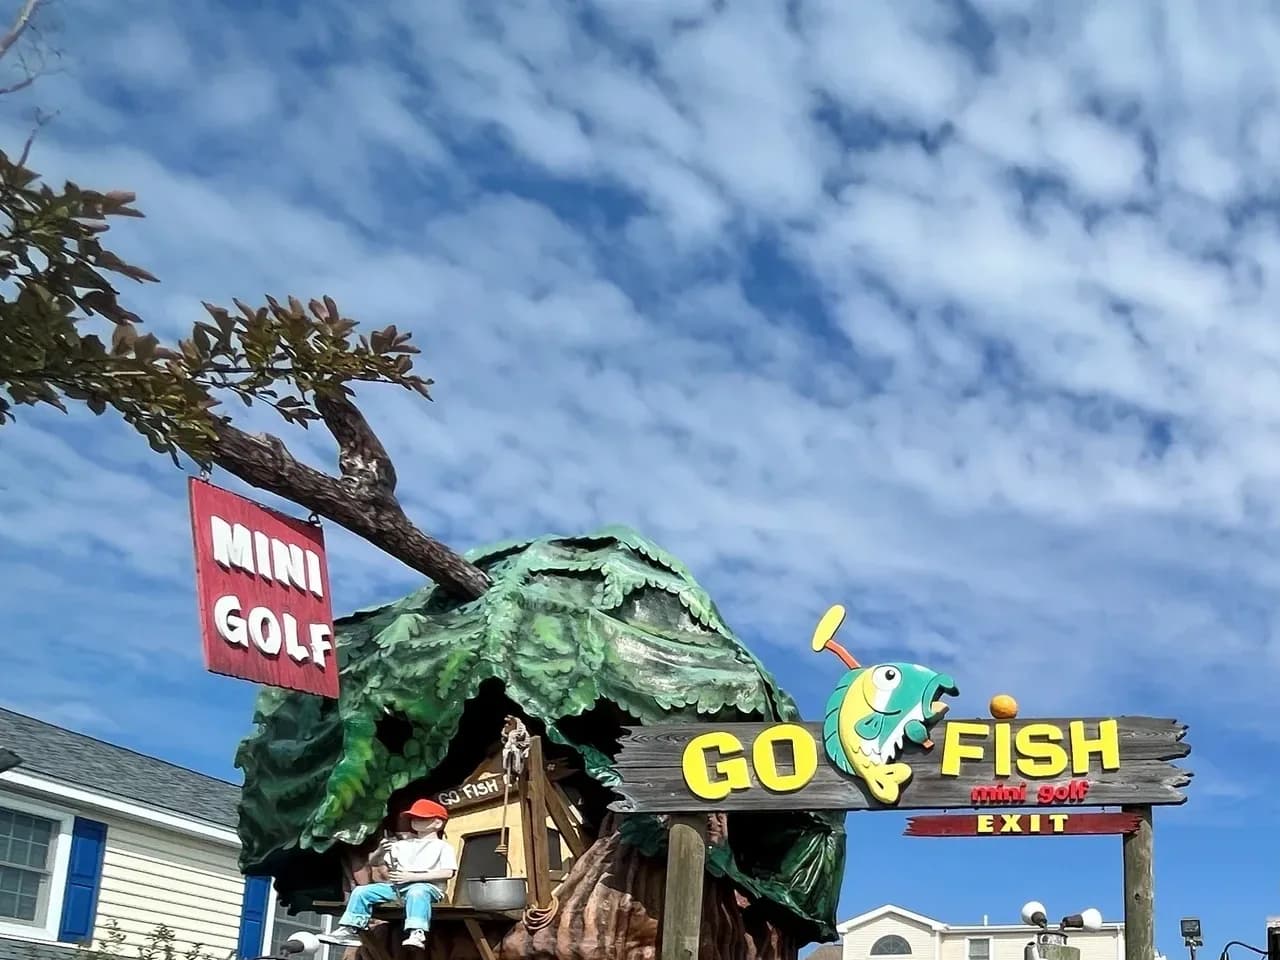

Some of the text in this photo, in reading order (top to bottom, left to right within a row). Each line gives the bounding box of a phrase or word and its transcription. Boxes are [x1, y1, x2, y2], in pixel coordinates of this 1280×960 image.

[211, 515, 323, 597] MINI
[214, 595, 332, 668] GOLF
[682, 719, 1121, 800] GO FISH
[438, 790, 461, 805] GO
[462, 779, 499, 799] FISH
[970, 778, 1090, 805] mini golf
[977, 814, 1069, 833] EXIT
